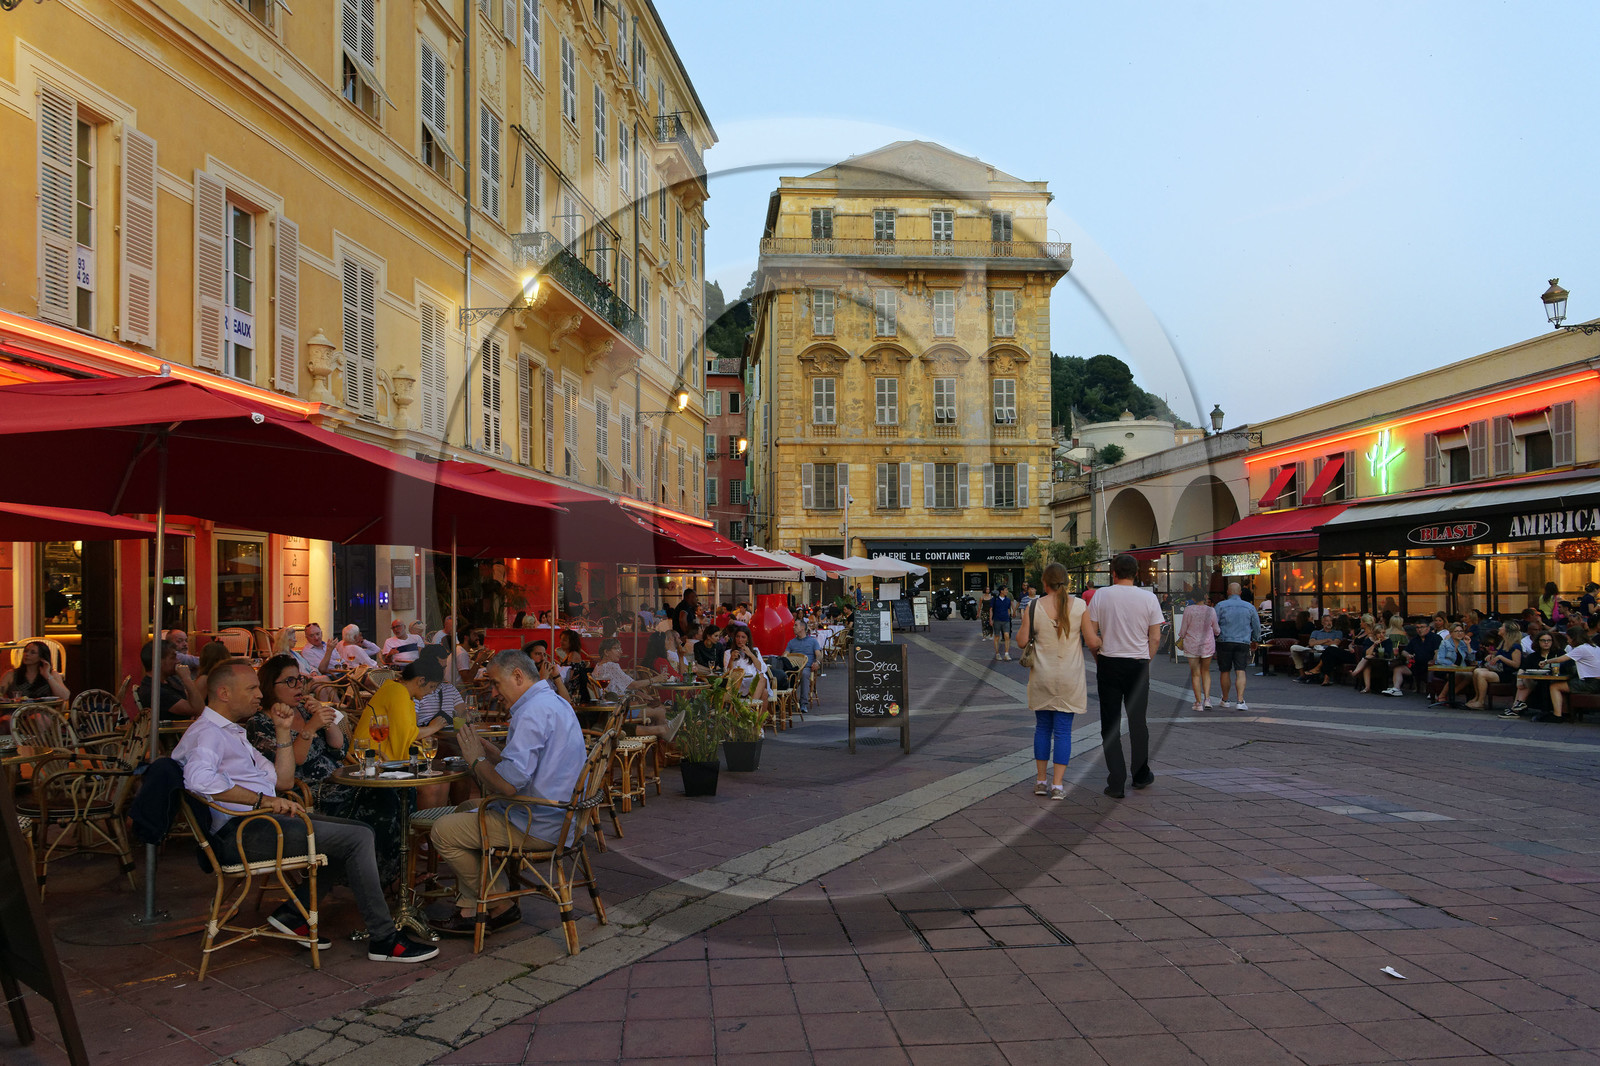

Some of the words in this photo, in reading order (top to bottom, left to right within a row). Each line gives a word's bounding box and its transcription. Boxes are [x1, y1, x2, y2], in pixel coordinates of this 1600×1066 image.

[82, 272, 90, 285] 26
[233, 318, 252, 339] EAUX
[1508, 508, 1600, 538] AMERICA
[1419, 523, 1477, 542] BLAST
[910, 552, 921, 560] LE
[925, 552, 971, 560] CONTAINER
[287, 582, 302, 598] Jus
[855, 649, 901, 673] Socca
[882, 690, 897, 702] de
[855, 702, 875, 715] Rosé
